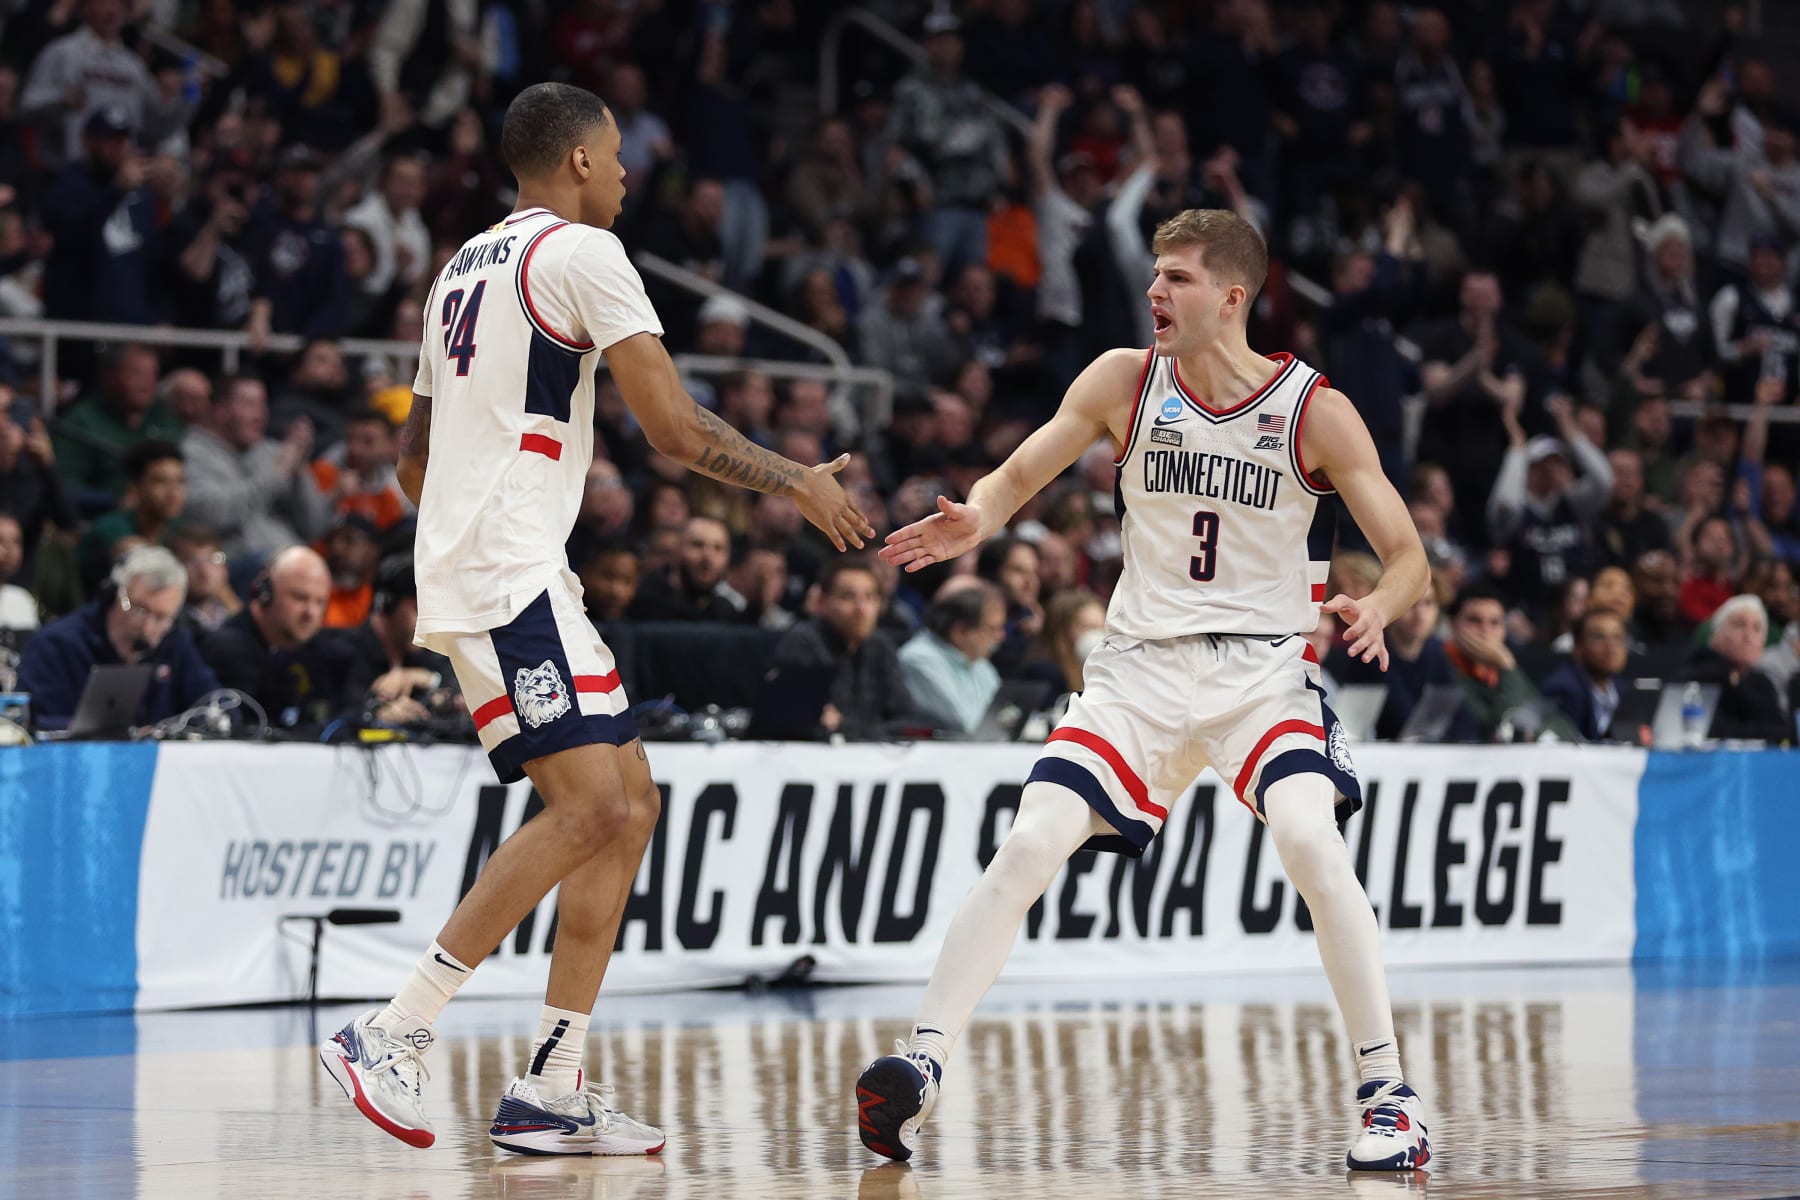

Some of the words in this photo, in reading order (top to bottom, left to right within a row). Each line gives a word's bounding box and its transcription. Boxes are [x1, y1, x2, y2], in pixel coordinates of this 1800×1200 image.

[444, 236, 517, 281] HAWKINS
[442, 280, 487, 376] 24
[1255, 440, 1285, 449] EAST
[1260, 435, 1280, 443] BIG
[695, 446, 788, 492] LOYALTY
[1144, 450, 1283, 510] CONNECTICUT
[1189, 511, 1220, 582] 3
[220, 841, 371, 898] HOSTED
[377, 841, 437, 898] BY
[457, 784, 738, 954] AC
[750, 783, 946, 946] AND
[977, 783, 1216, 938] ENA
[1240, 779, 1571, 934] CLLEGE
